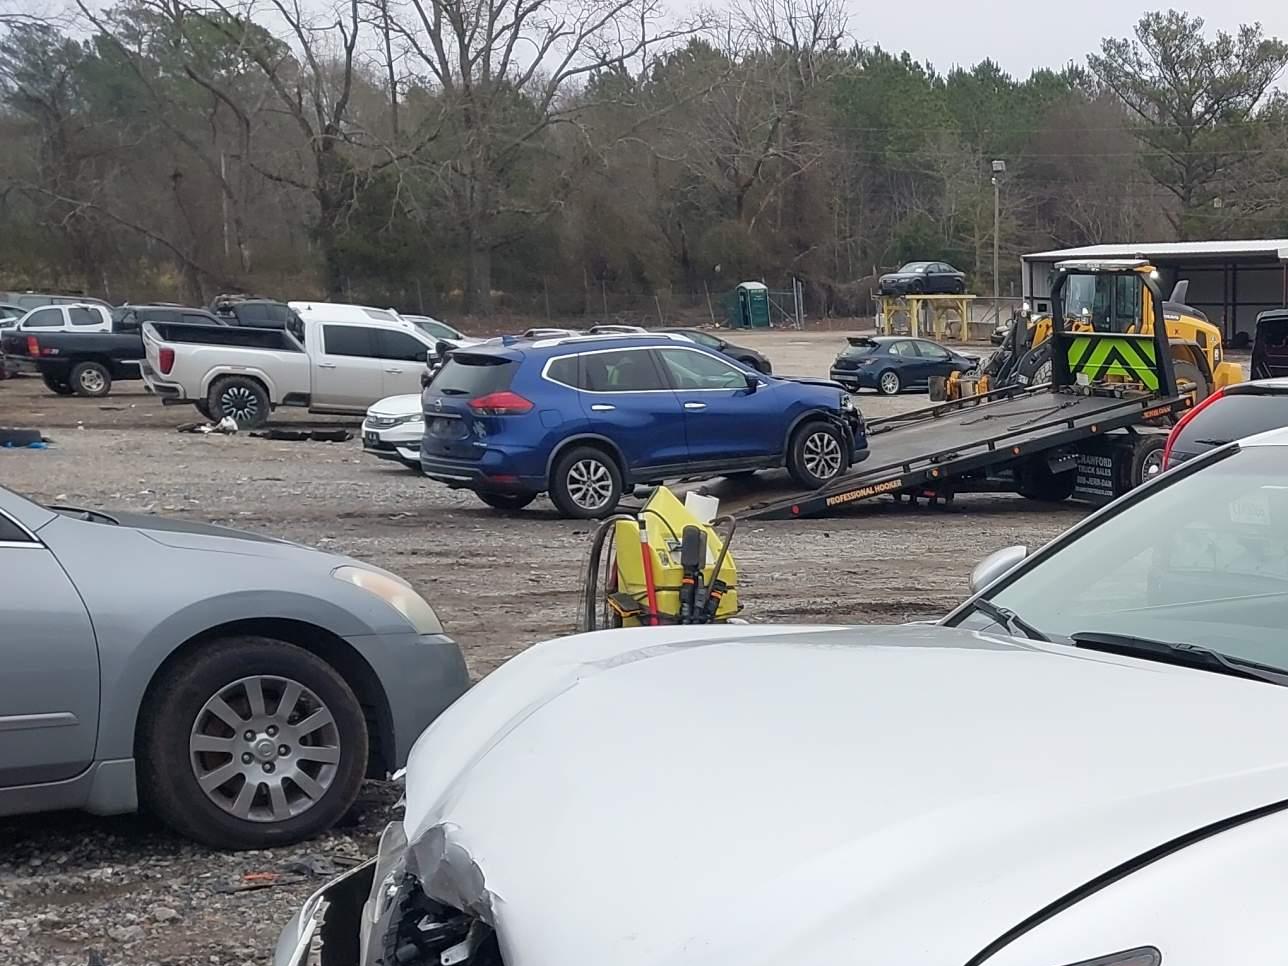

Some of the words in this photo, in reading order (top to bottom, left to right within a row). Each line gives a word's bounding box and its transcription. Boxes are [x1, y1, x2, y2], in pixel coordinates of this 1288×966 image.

[1095, 467, 1112, 476] SALES
[826, 486, 874, 506] PROFESSIONAL
[874, 479, 902, 492] HOOKER
